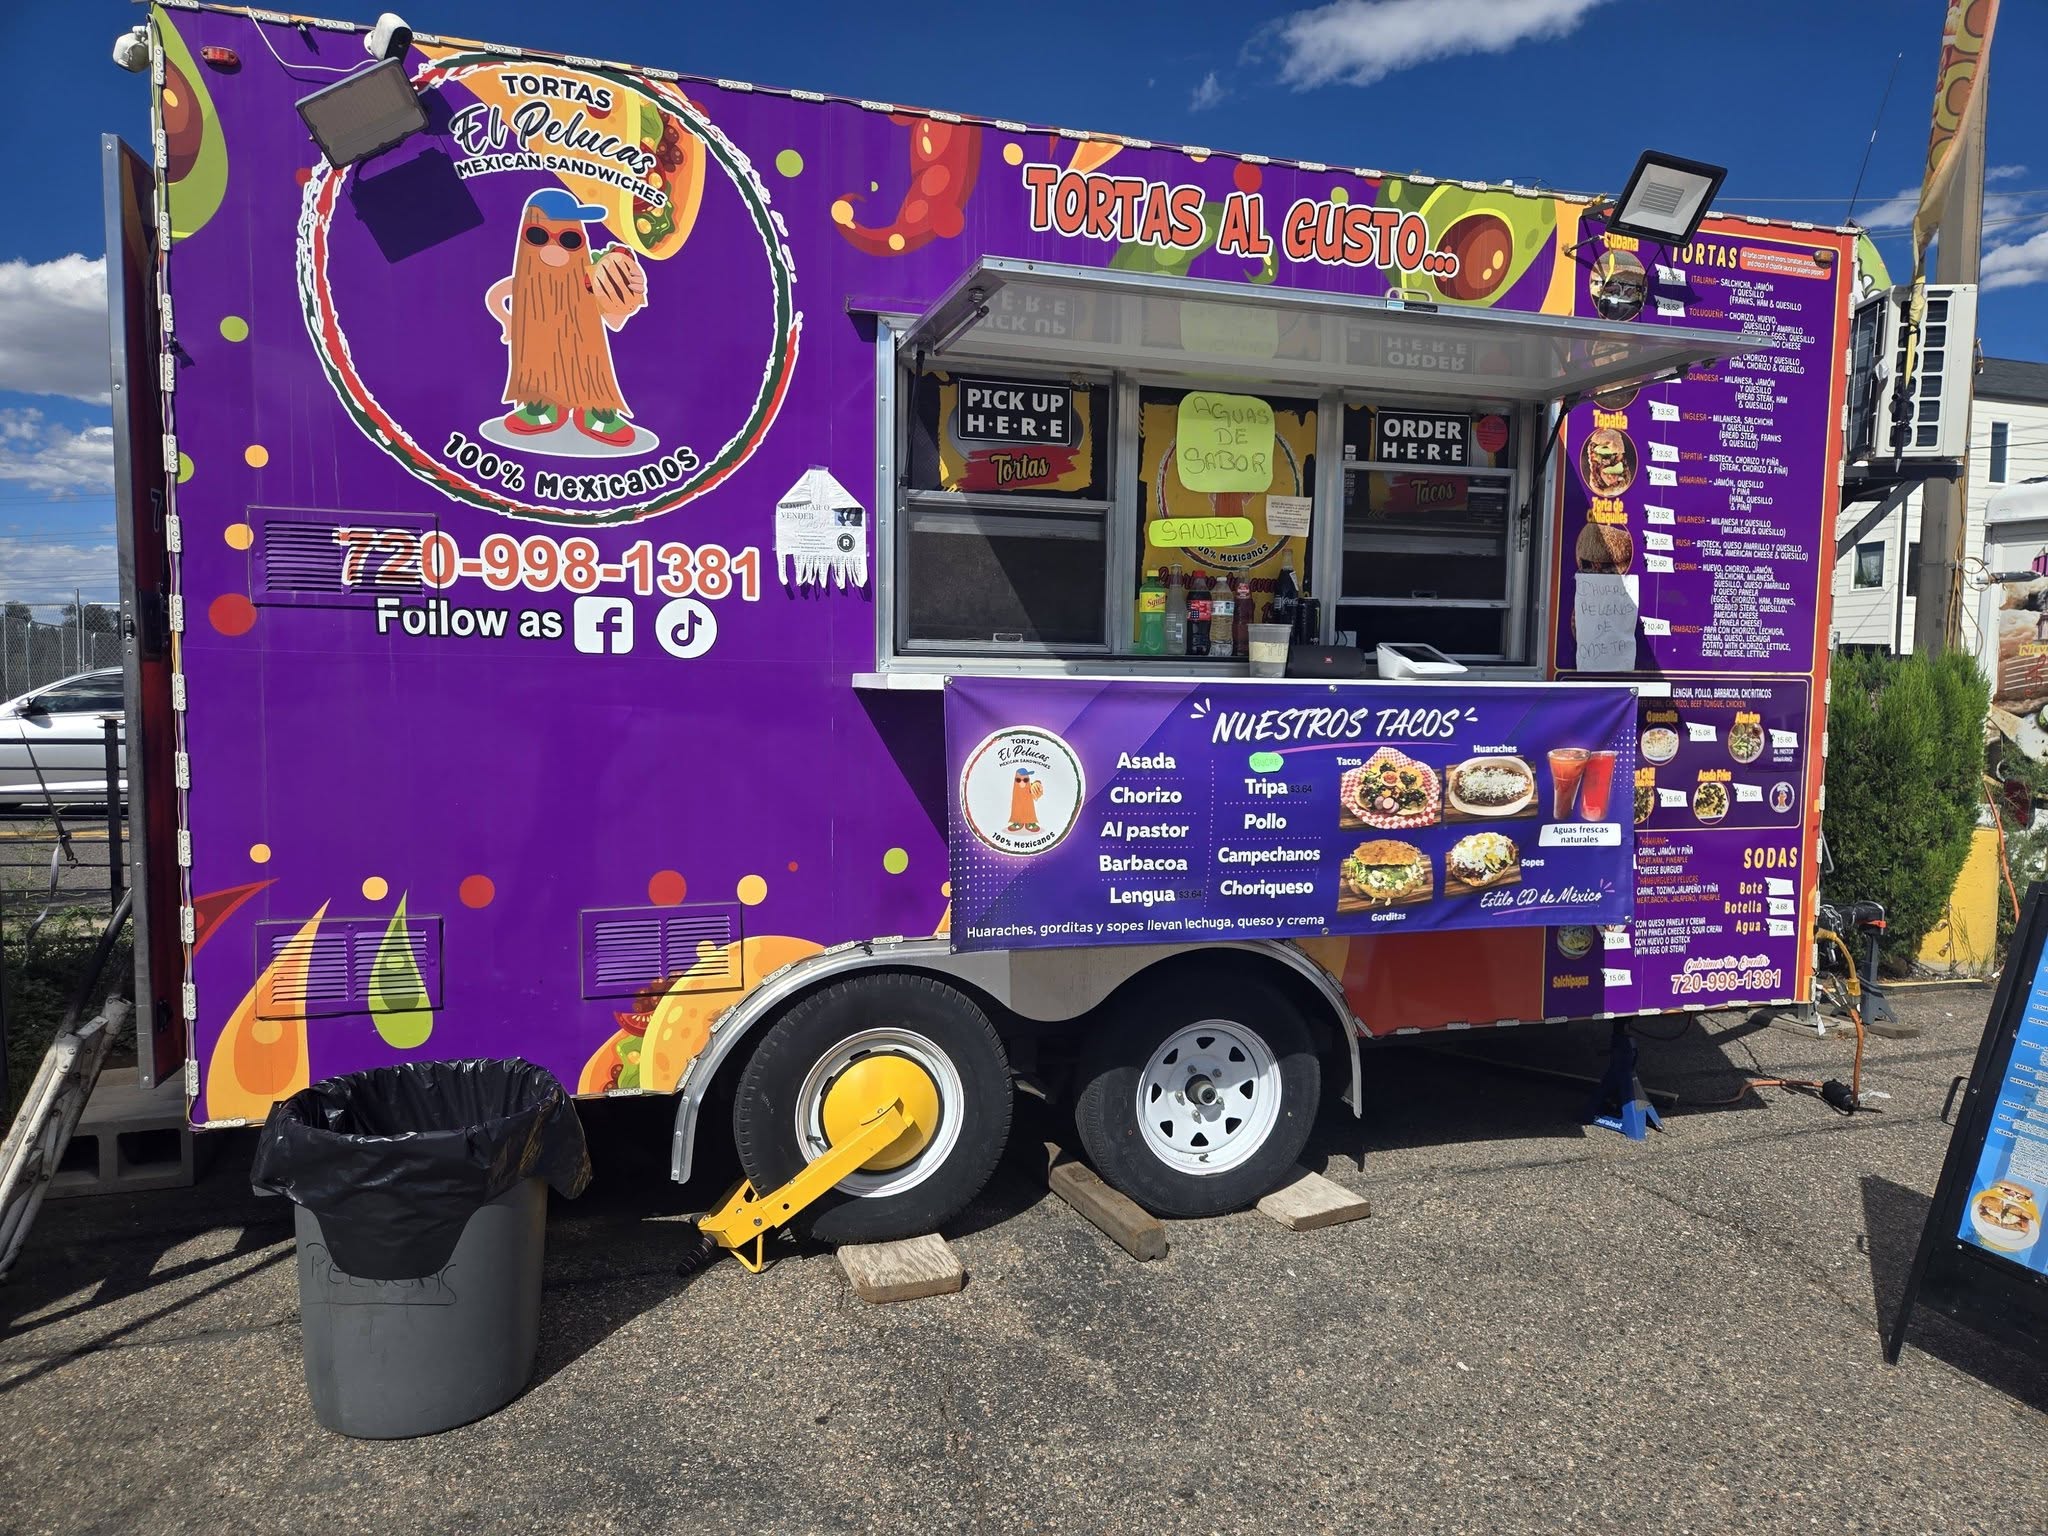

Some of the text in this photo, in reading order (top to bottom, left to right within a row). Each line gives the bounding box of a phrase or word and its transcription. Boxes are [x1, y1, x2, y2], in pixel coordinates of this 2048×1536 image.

[501, 74, 611, 109] TORTAS
[448, 101, 656, 176] El Pelucas
[455, 154, 668, 208] MEXICAN SANDWICHES
[1025, 166, 1459, 276] TORTAS AL GUSTO...
[967, 388, 1064, 413] PICK UP
[1193, 396, 1269, 427] AGUAS
[1657, 408, 1674, 416] 13.52
[1214, 427, 1248, 445] DE
[1384, 418, 1462, 440] ORDER
[1183, 447, 1266, 475] SABOR
[1655, 450, 1673, 458] 13.52
[443, 430, 698, 500] 100% Mexicanos
[989, 453, 1050, 485] Tortas
[1410, 480, 1455, 505] Tacos
[1652, 511, 1670, 520] 13.52
[1161, 521, 1239, 542] SANDIA
[1651, 538, 1668, 546] 13.52
[333, 528, 761, 601] 720-998-1381
[518, 610, 564, 639] as
[1211, 706, 1459, 744] NUESTROS TACOS
[1011, 738, 1040, 747] TORTAS
[1473, 743, 1517, 754] Huaraches
[997, 745, 1050, 762] El Pelucas
[1116, 752, 1176, 770] Asada
[1336, 757, 1362, 766] Tacos
[1110, 786, 1182, 804] Chorizo
[1244, 777, 1313, 799] Tripa $3.64
[1244, 812, 1287, 830] Pollo
[1553, 824, 1609, 836] Aguas frescas
[991, 831, 1012, 847] 100%
[1101, 821, 1190, 843] Al pastor
[1560, 834, 1599, 844] naturales
[1100, 855, 1188, 872] Barbacoa
[1217, 846, 1321, 866] Campechanos
[1521, 857, 1545, 868] Sopes
[1743, 846, 1798, 869] SODAS
[1110, 886, 1176, 908] Lengua
[1220, 879, 1314, 899] Choriqueso
[1480, 884, 1604, 909] Estilo CD de México
[1739, 882, 1763, 895] Bote
[967, 914, 1325, 939] Huaraches, gorditas y sopes llevan lechuga, queso y crema
[1371, 912, 1406, 922] Gorditas
[1735, 919, 1761, 935] Agua
[1670, 969, 1782, 995] 720-998-1381
